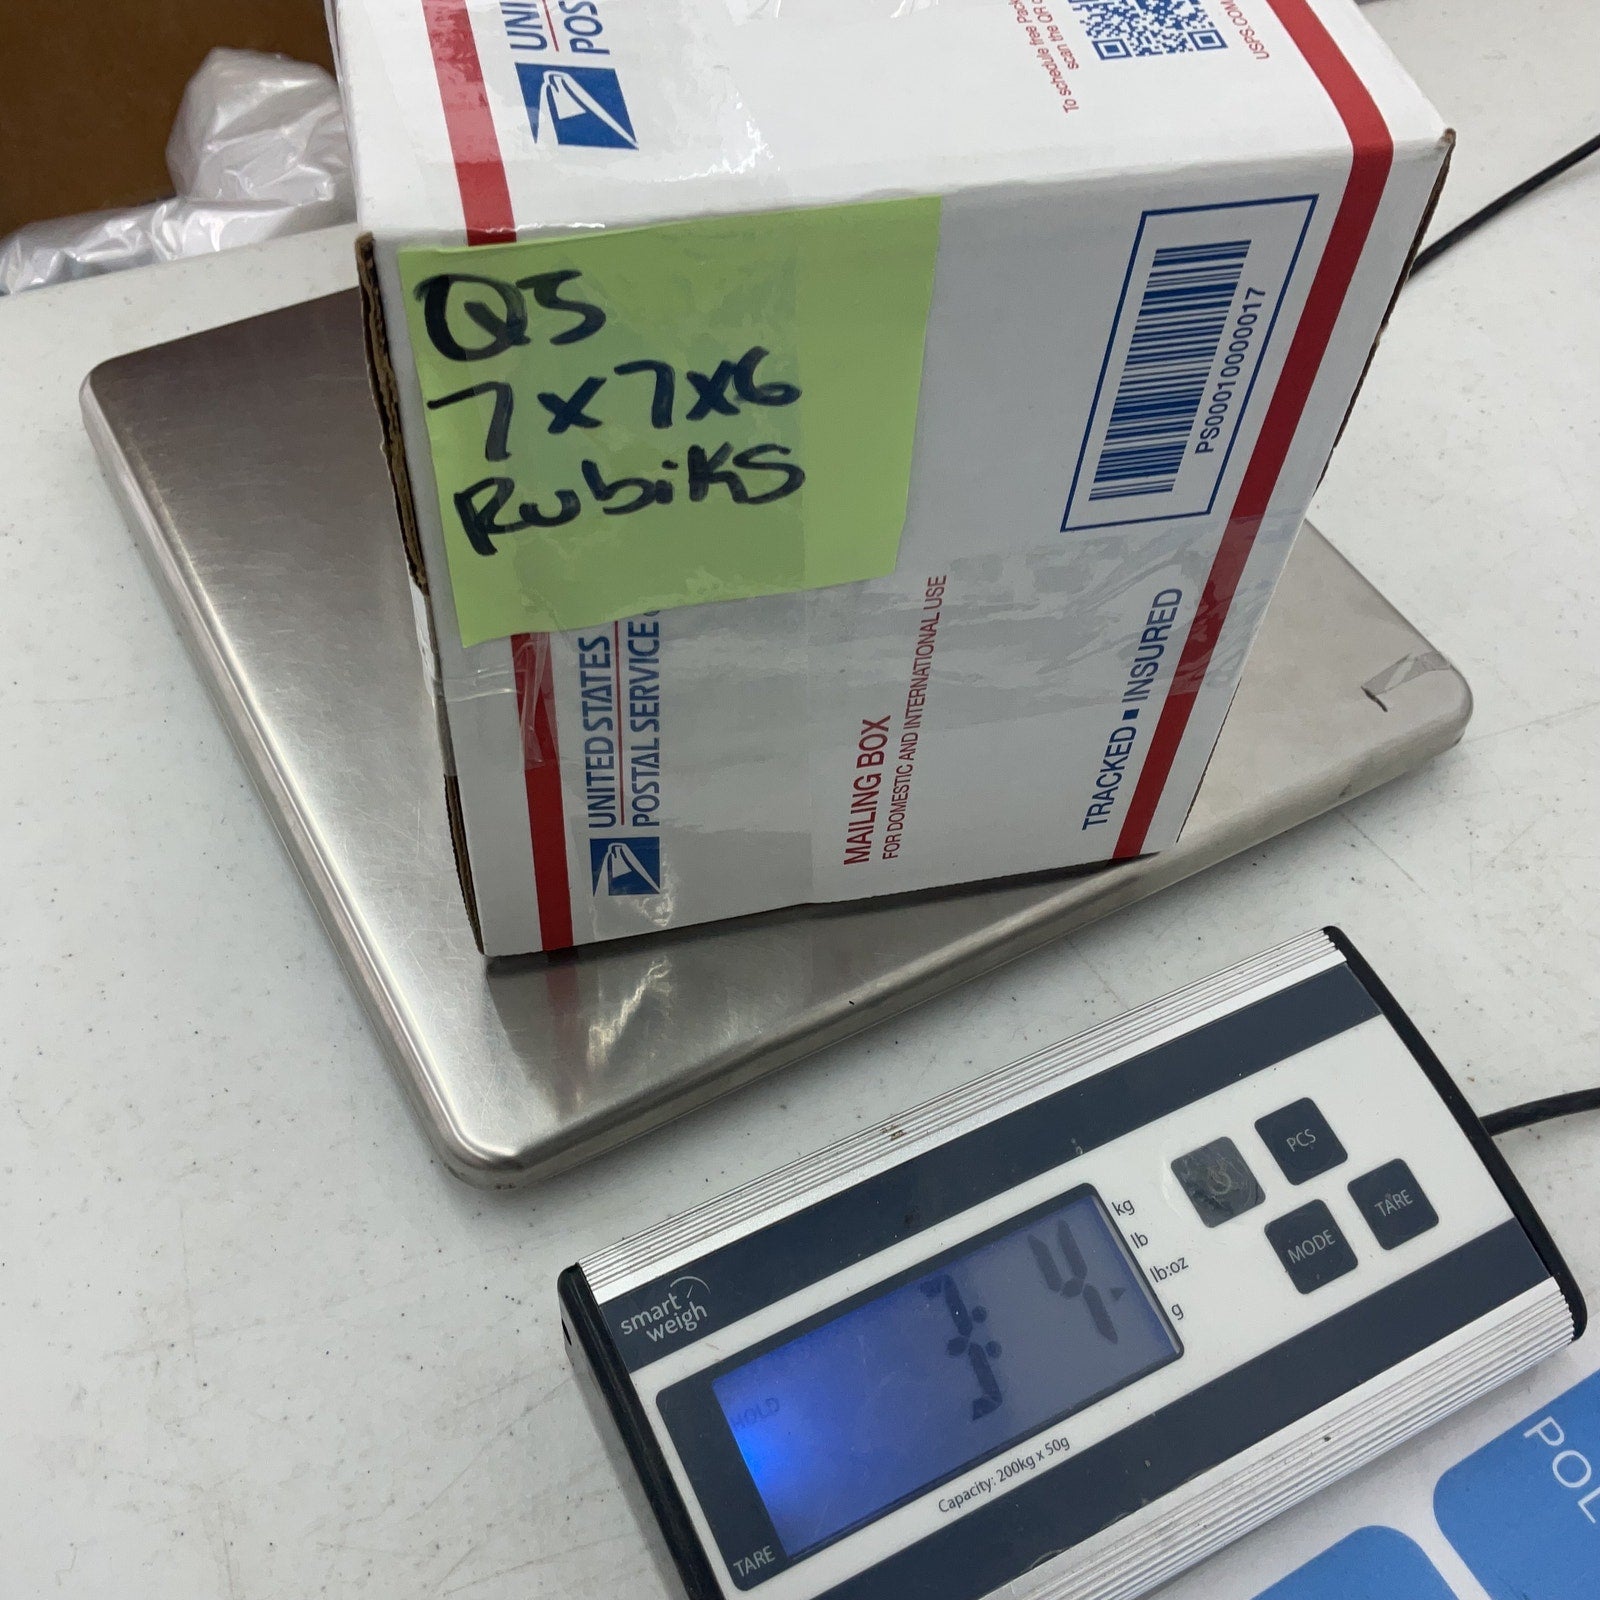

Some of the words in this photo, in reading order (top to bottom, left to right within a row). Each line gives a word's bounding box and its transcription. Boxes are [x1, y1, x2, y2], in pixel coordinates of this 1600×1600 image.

[558, 0, 610, 55] POS
[1033, 6, 1053, 23] QR
[1025, 25, 1045, 45] free
[1047, 25, 1064, 42] the
[1037, 47, 1072, 96] schedule
[1057, 44, 1080, 70] scan
[1063, 99, 1079, 113] To
[1195, 286, 1267, 455] PS00010000017
[923, 574, 948, 611] USE
[578, 635, 614, 732] STATES
[904, 611, 941, 730] INTERNATIONAL
[1081, 725, 1138, 831] TRACKED
[1121, 587, 1183, 704] INSURED
[856, 714, 892, 770] BOX
[898, 731, 919, 761] AND
[584, 735, 617, 829] UNITED
[630, 737, 661, 828] POSTAL
[889, 764, 914, 831] DOMESTIC
[843, 772, 882, 866] MAILING
[882, 829, 904, 861] FOR
[1286, 1128, 1317, 1153] PCS
[1111, 1197, 1136, 1218] kg
[1374, 1189, 1414, 1218] TARE
[1130, 1231, 1149, 1250] lb
[1286, 1228, 1337, 1265] MODE
[1149, 1255, 1190, 1284] lb:oz
[620, 1292, 683, 1336] smart
[646, 1300, 708, 1343] weigh
[1171, 1301, 1184, 1321] g
[937, 1475, 997, 1513] Capacity:
[995, 1455, 1036, 1483] 200kg
[1044, 1436, 1071, 1456] 50g
[1522, 1415, 1600, 1525] POL
[732, 1544, 776, 1578] TARE
